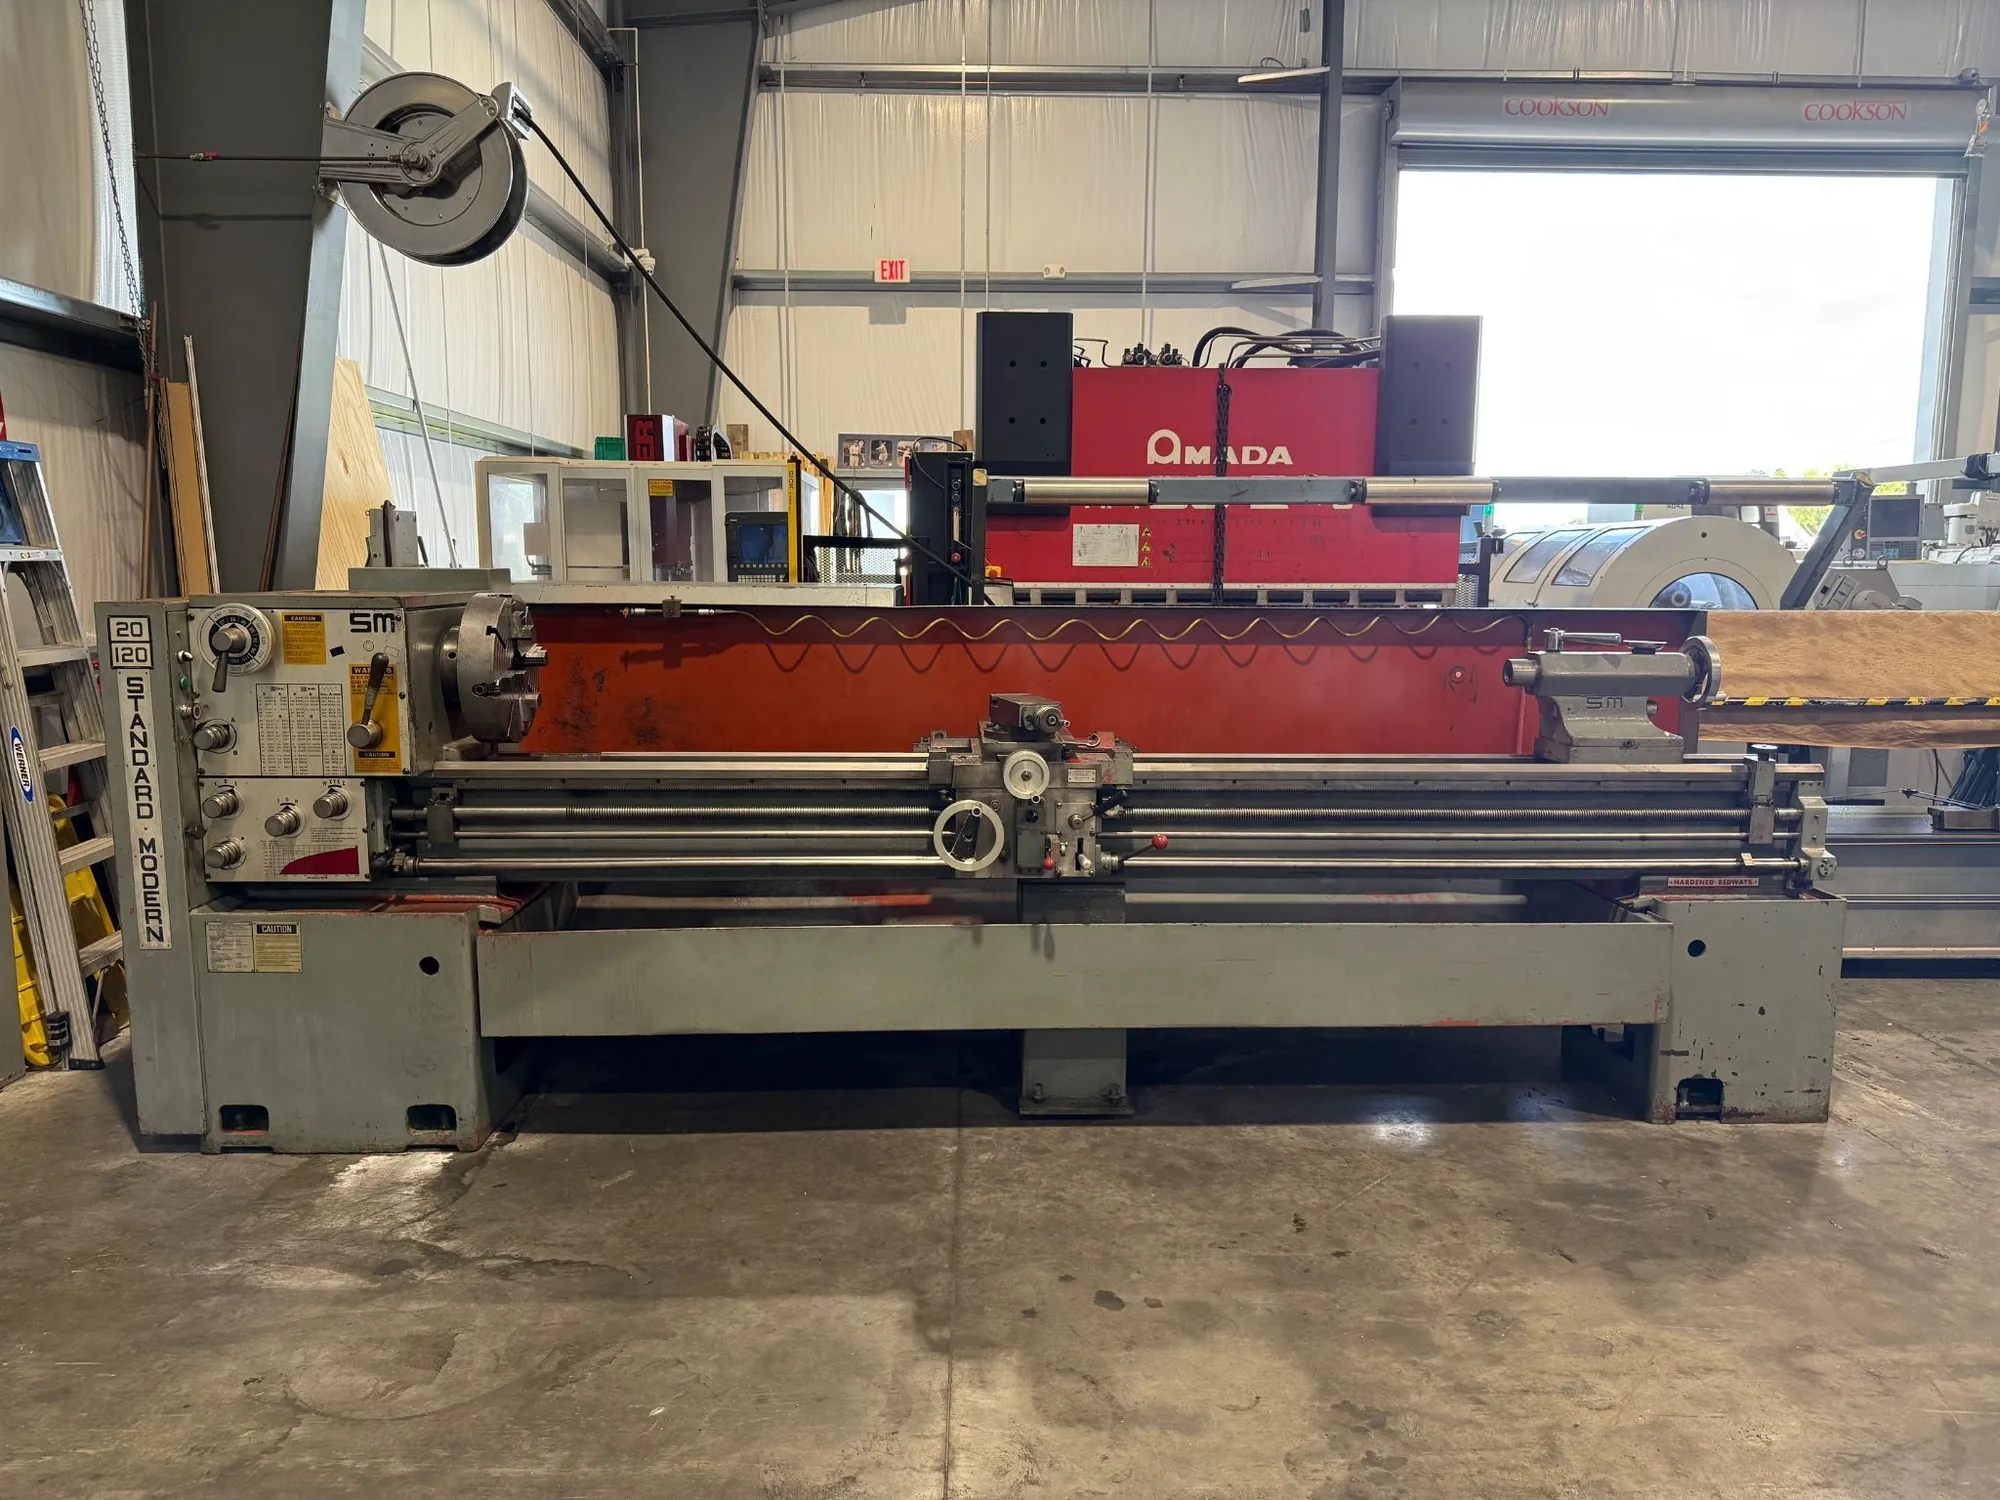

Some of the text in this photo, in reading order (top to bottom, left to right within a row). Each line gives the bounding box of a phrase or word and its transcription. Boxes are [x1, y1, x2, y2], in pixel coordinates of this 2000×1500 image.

[1504, 97, 1609, 117] COOKSON
[1803, 100, 1908, 121] COOKSON
[880, 260, 905, 280] EXIT
[116, 621, 143, 637] 20
[115, 646, 148, 662] 120
[14, 743, 30, 787] WERNER
[127, 677, 165, 942] STANDARD MODERN
[261, 925, 292, 933] CAUTION
